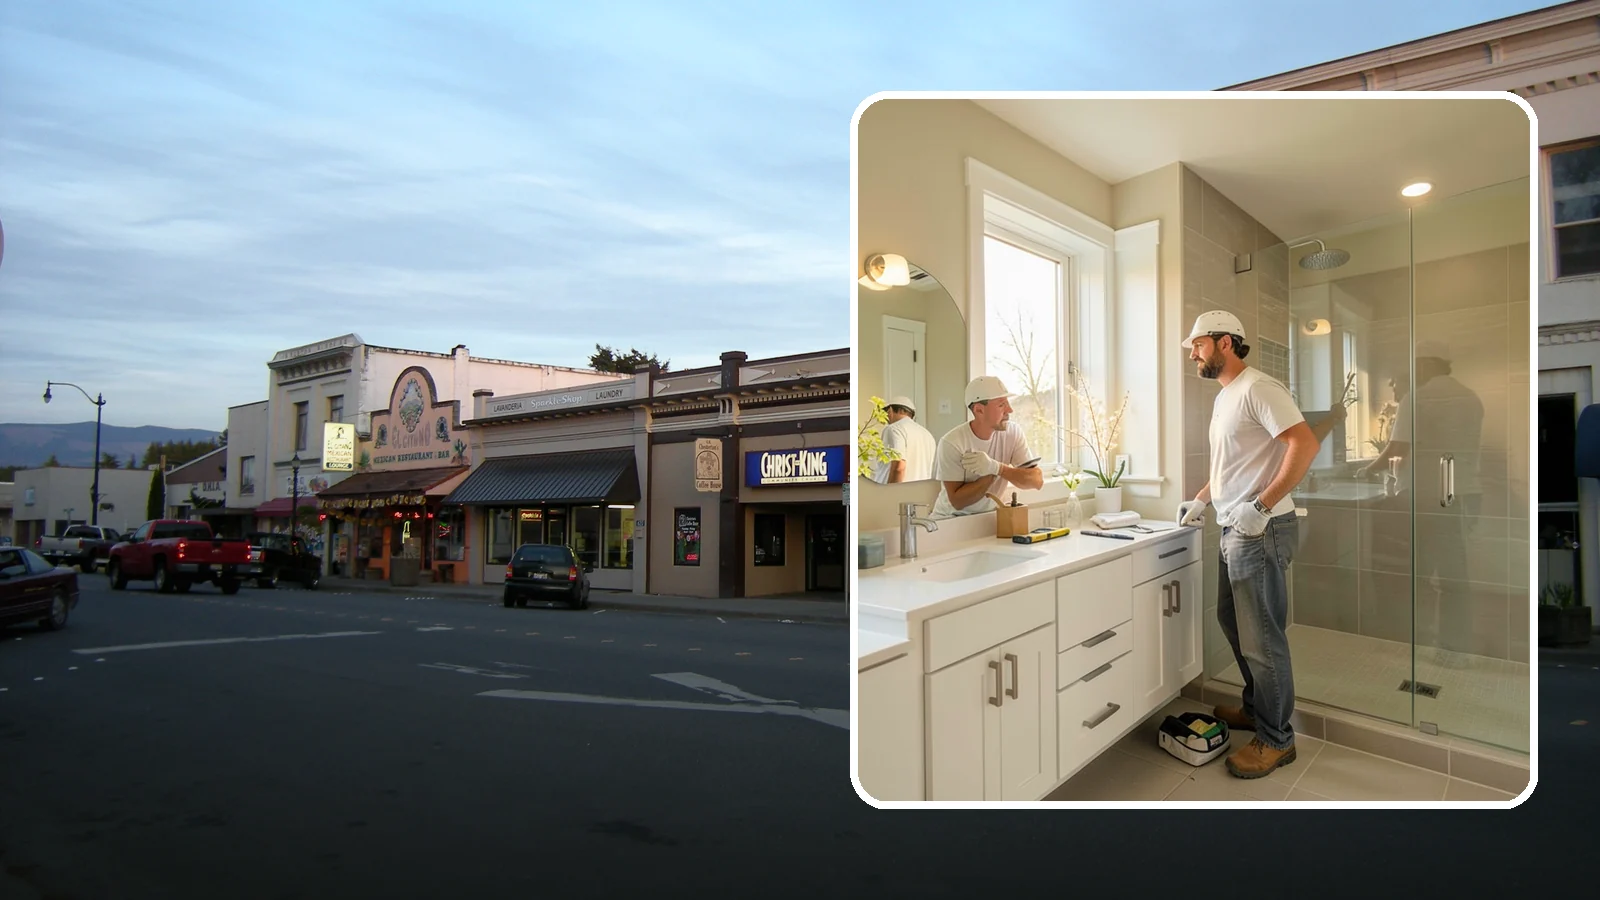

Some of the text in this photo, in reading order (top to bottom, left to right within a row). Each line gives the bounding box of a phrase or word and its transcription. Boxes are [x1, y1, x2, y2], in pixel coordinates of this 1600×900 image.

[562, 394, 582, 405] Shop
[595, 388, 623, 400] LAUNDRY
[493, 402, 523, 413] LAVANDERIA
[374, 450, 450, 464] MEXICAN RESTAURANT BAR
[799, 450, 827, 476] KING
